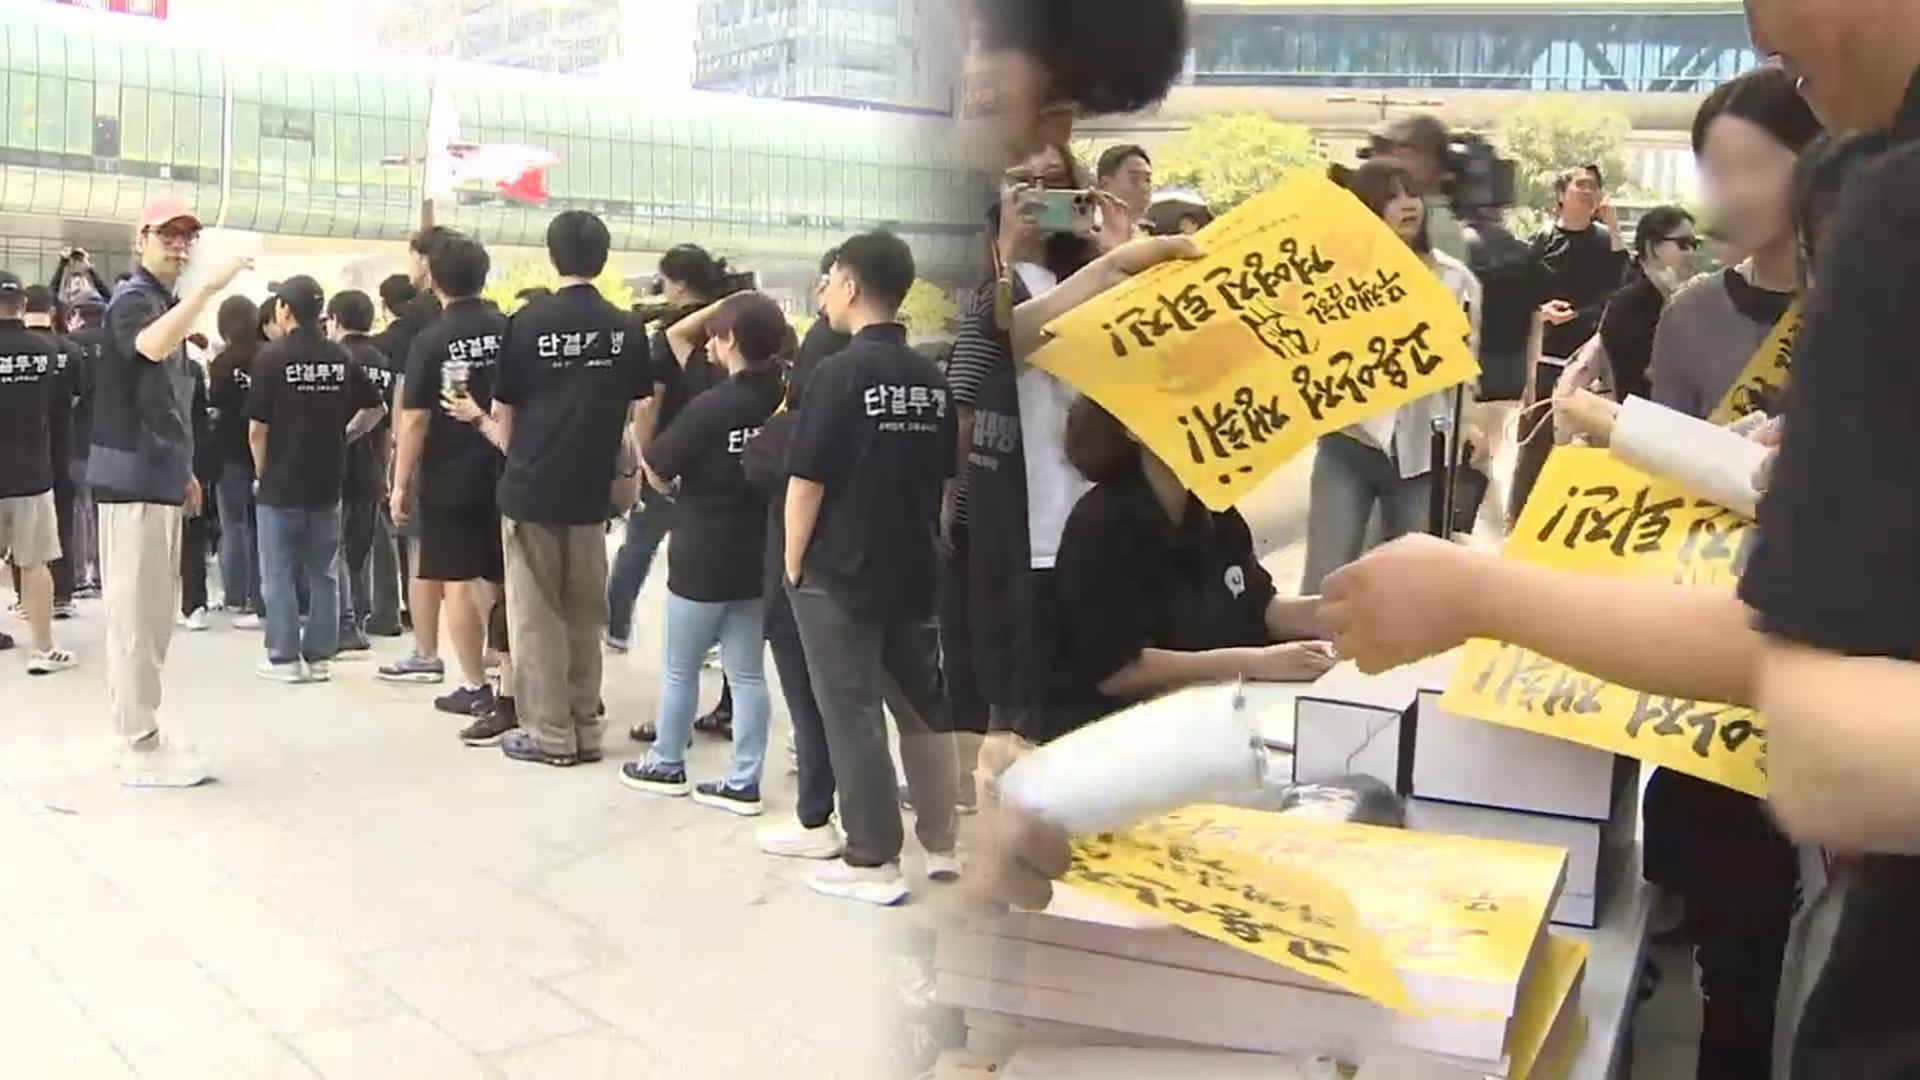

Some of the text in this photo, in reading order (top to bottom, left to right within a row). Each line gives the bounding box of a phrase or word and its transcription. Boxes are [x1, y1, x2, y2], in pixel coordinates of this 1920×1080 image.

[1101, 237, 1335, 357] 경영진 퇴진!
[1302, 268, 1407, 325] 무책임한
[285, 363, 345, 383] 단결투쟁
[448, 335, 502, 361] 단결투
[1177, 321, 1443, 464] 고용안정 쟁취!
[1536, 485, 1685, 557] 퇴진!
